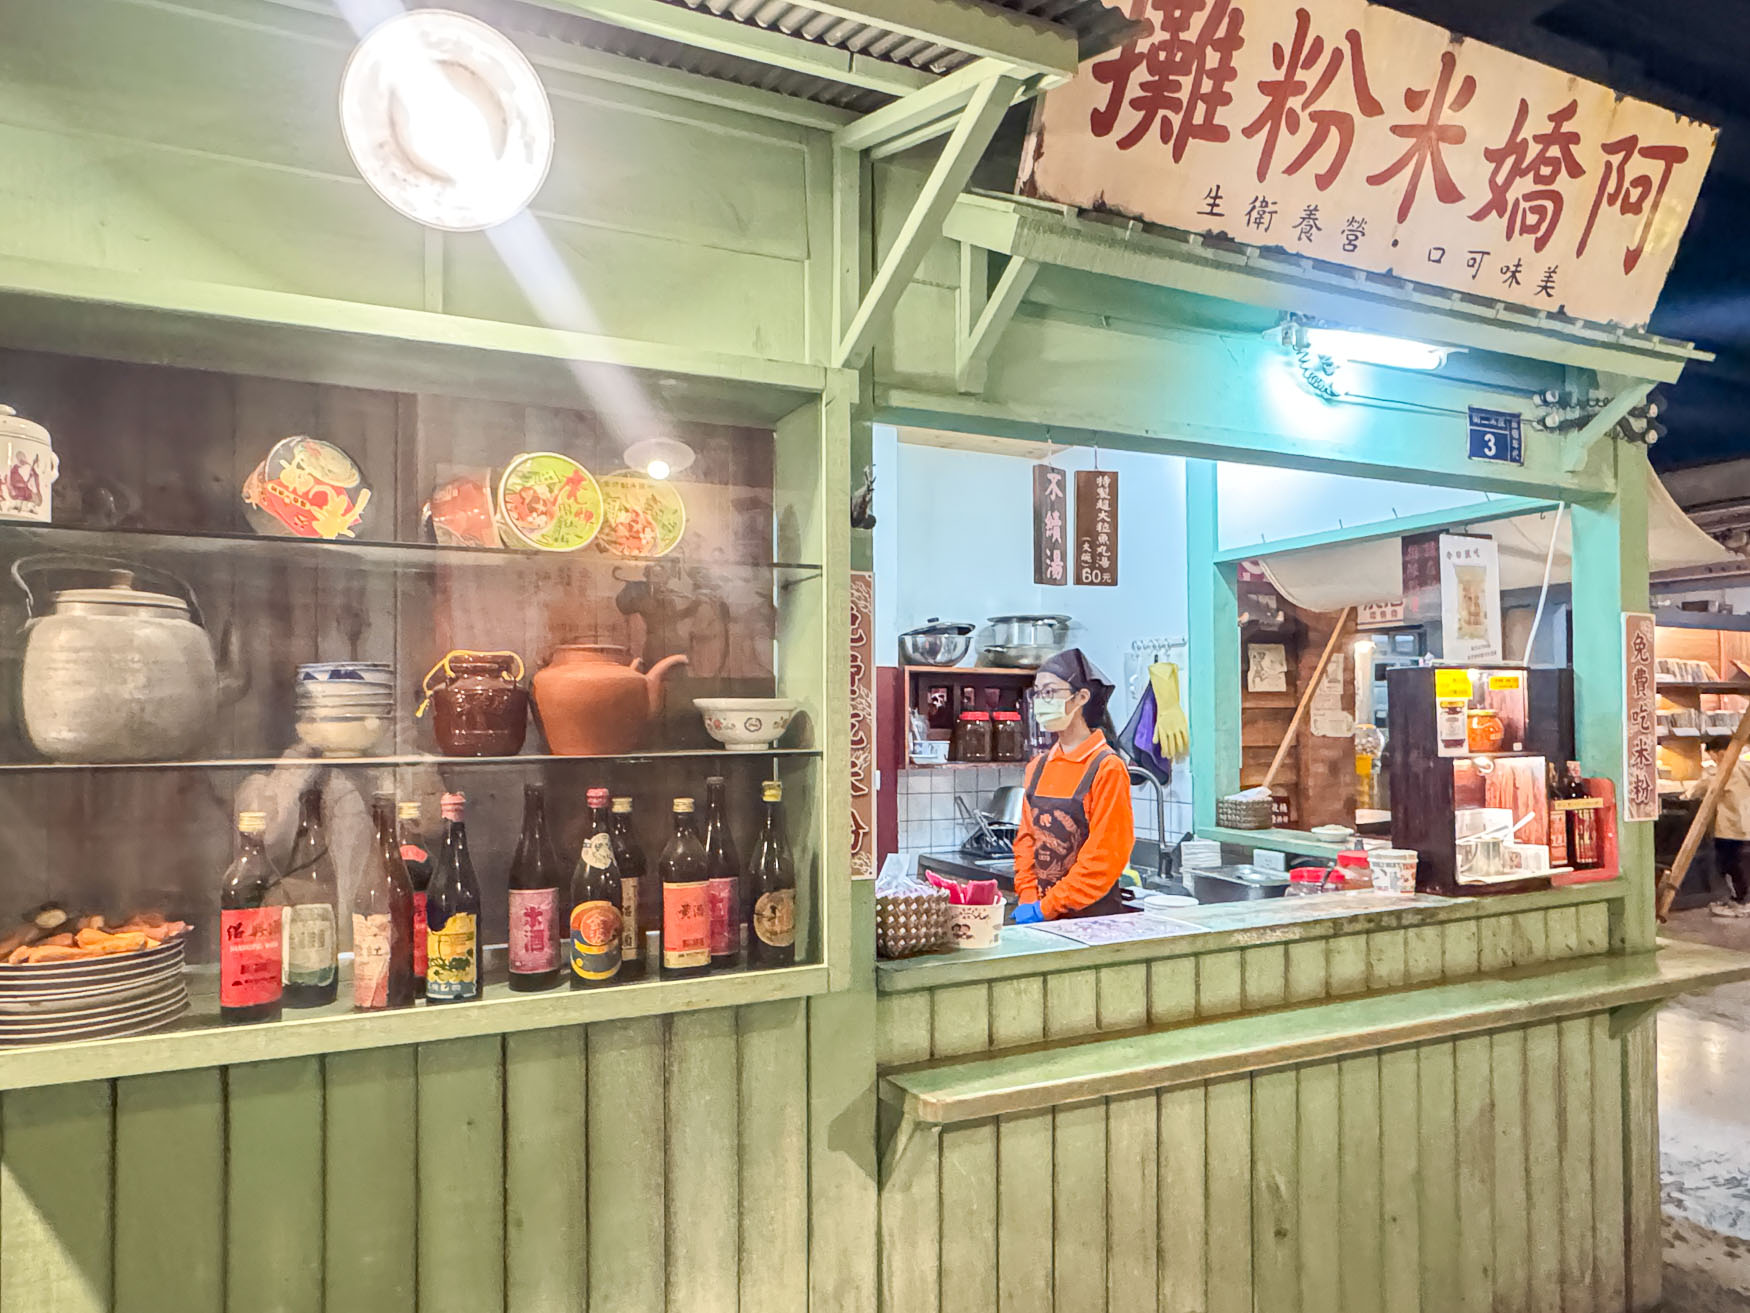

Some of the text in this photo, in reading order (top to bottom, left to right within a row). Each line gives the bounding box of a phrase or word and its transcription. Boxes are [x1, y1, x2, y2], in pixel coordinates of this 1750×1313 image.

[1484, 433, 1497, 456] 3
[1631, 632, 1652, 804] 免費吃米粉
[523, 906, 546, 953] 米酒
